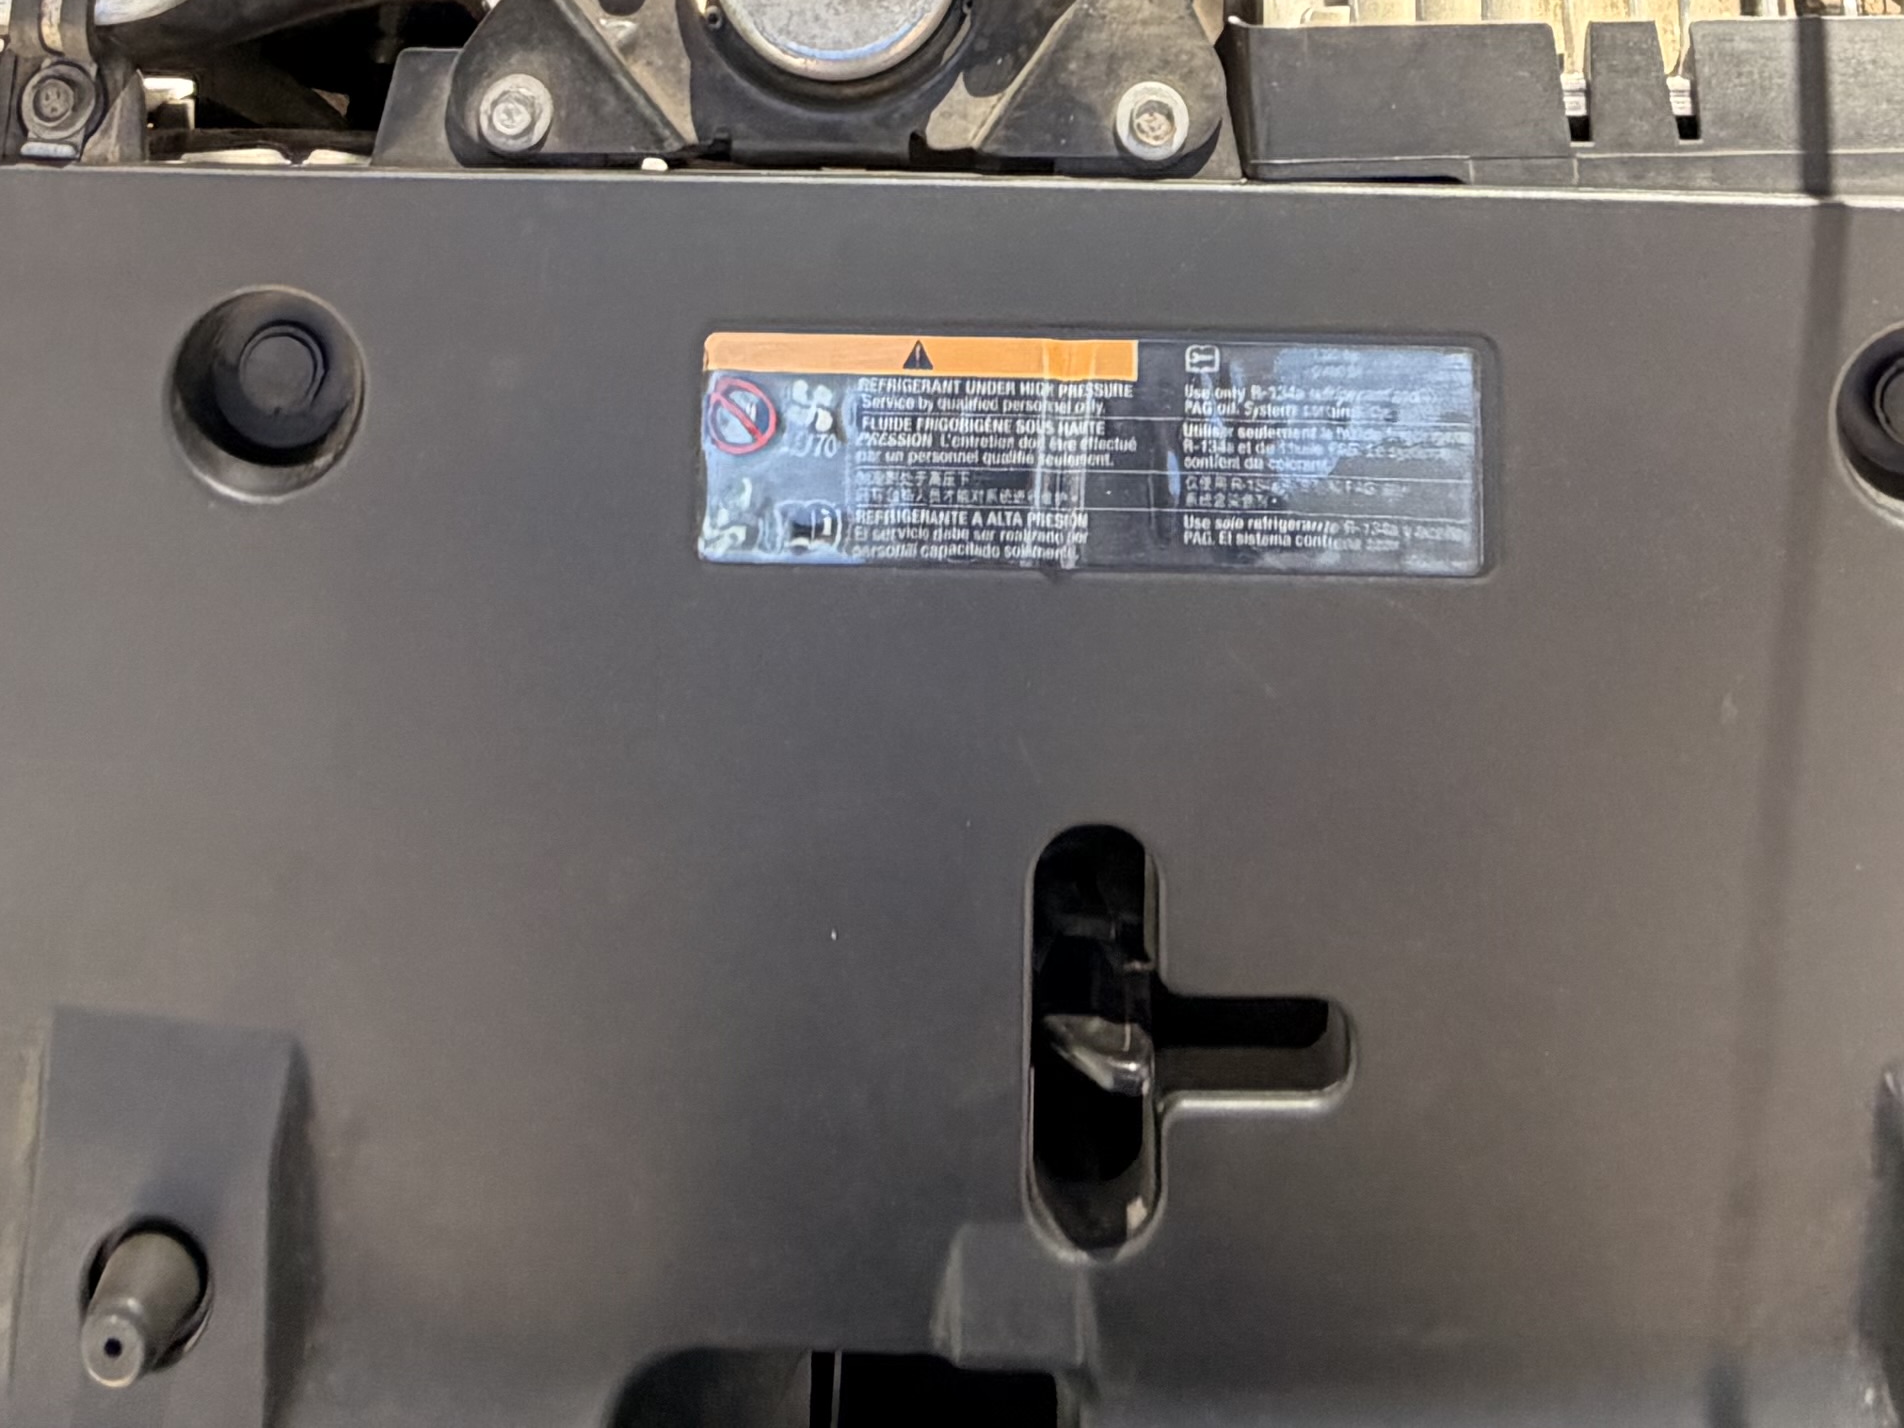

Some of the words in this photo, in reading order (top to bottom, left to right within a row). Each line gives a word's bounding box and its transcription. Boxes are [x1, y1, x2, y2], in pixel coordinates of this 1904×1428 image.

[857, 377, 962, 394] REFRIGERANT
[965, 379, 1016, 396] UNDER
[1058, 381, 1134, 398] PRESSURE
[1184, 384, 1211, 398] Use
[1214, 386, 1246, 403] only
[862, 394, 915, 410] Service
[918, 396, 934, 413] by
[937, 396, 999, 413] qualified
[862, 416, 913, 431] FLUIDE
[908, 450, 979, 465] personnel
[856, 508, 969, 525] REFRIGERANTE
[972, 511, 984, 526] A
[987, 511, 1024, 527] ALTA
[1183, 514, 1211, 530] Use
